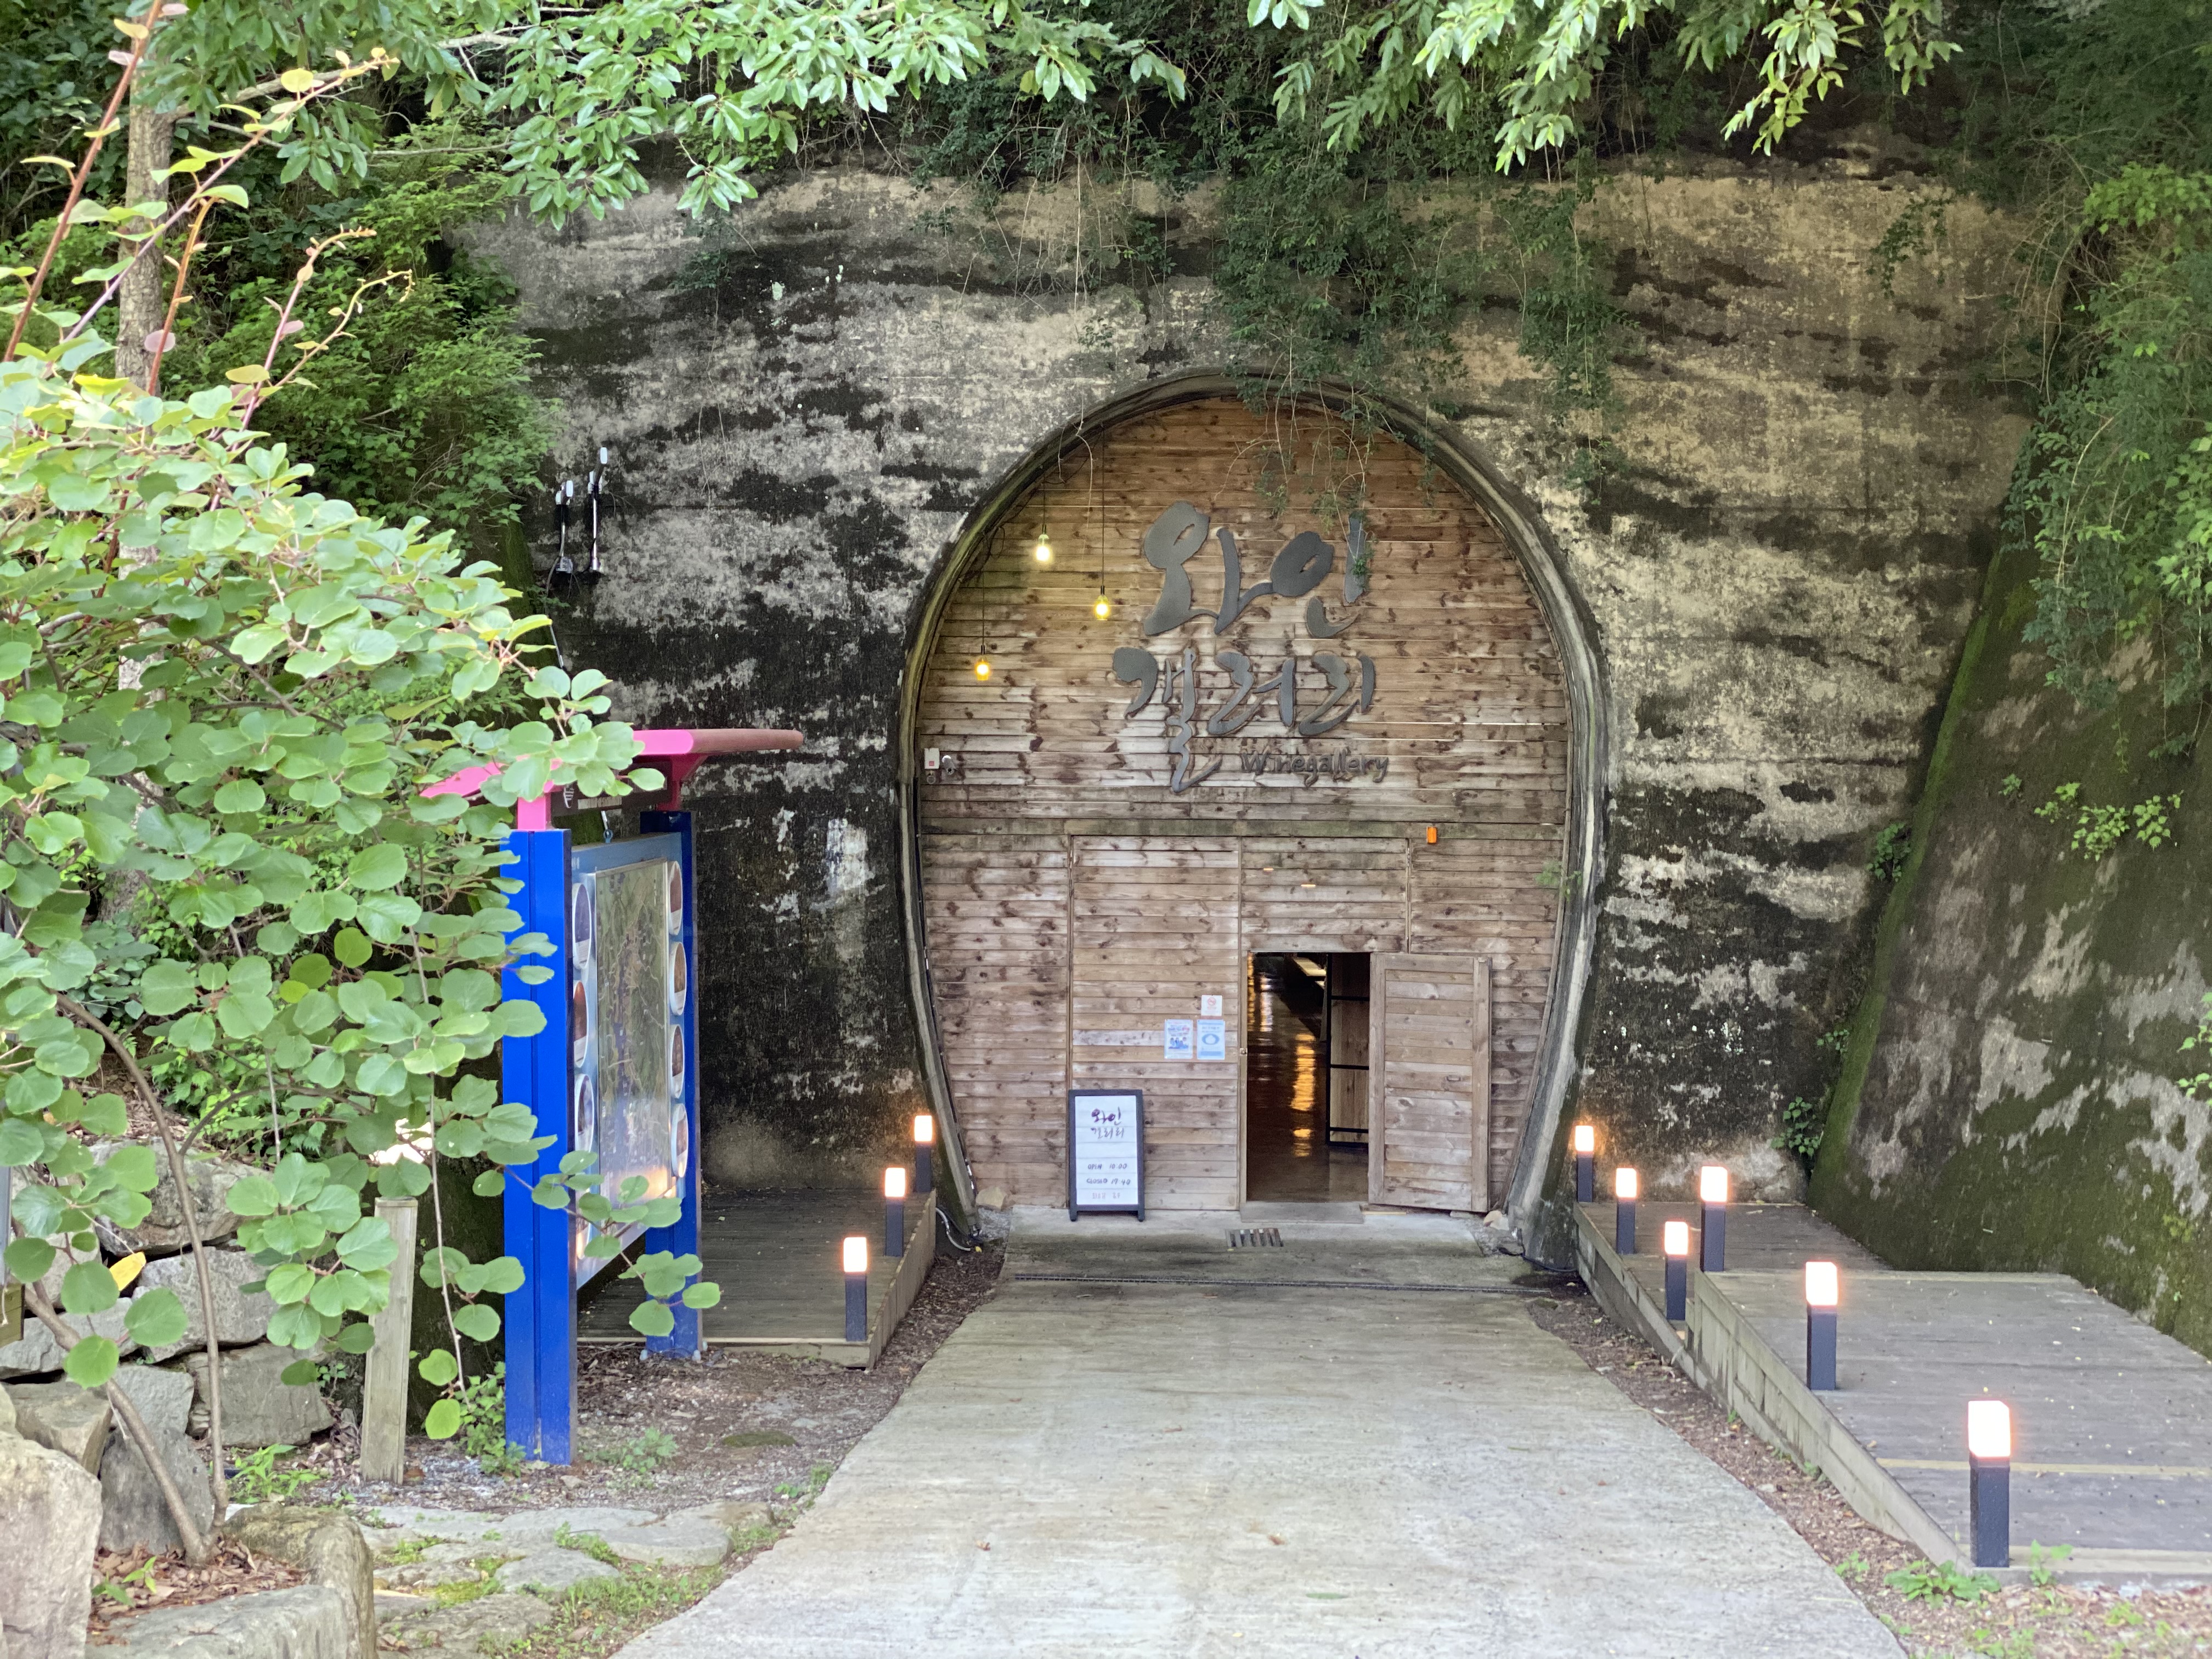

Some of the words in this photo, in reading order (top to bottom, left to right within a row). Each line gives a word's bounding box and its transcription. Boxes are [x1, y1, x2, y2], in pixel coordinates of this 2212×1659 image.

[1143, 500, 1368, 639] 와인
[1111, 647, 1376, 794] 갤러리
[1091, 1106, 1122, 1126] 와인
